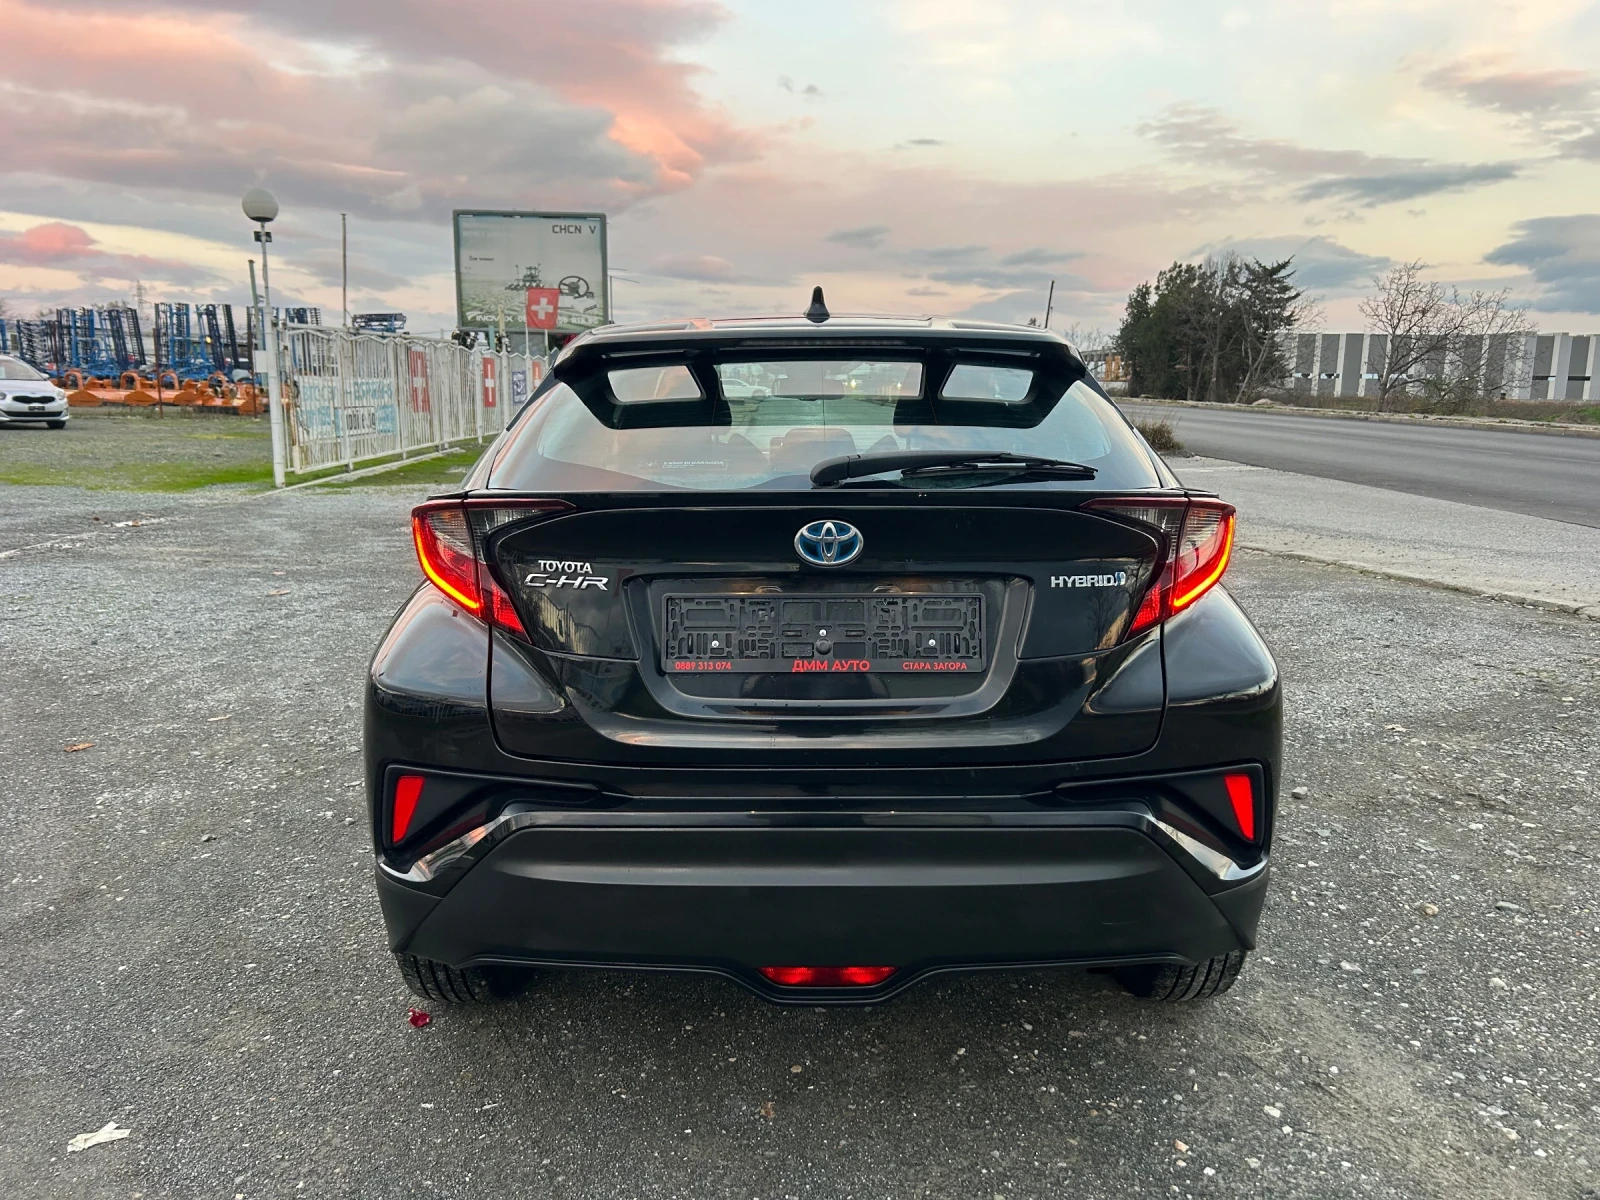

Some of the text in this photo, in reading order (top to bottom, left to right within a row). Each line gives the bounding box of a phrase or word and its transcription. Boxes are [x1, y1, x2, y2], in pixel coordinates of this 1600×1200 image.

[538, 560, 593, 574] TOYOTA
[524, 573, 609, 591] C-HR
[1051, 574, 1116, 588] HYBRID
[675, 661, 732, 670] 0889 313 074
[792, 660, 871, 672] ДММ АУТО
[903, 662, 967, 670] СТАРА ЗАГОРА
